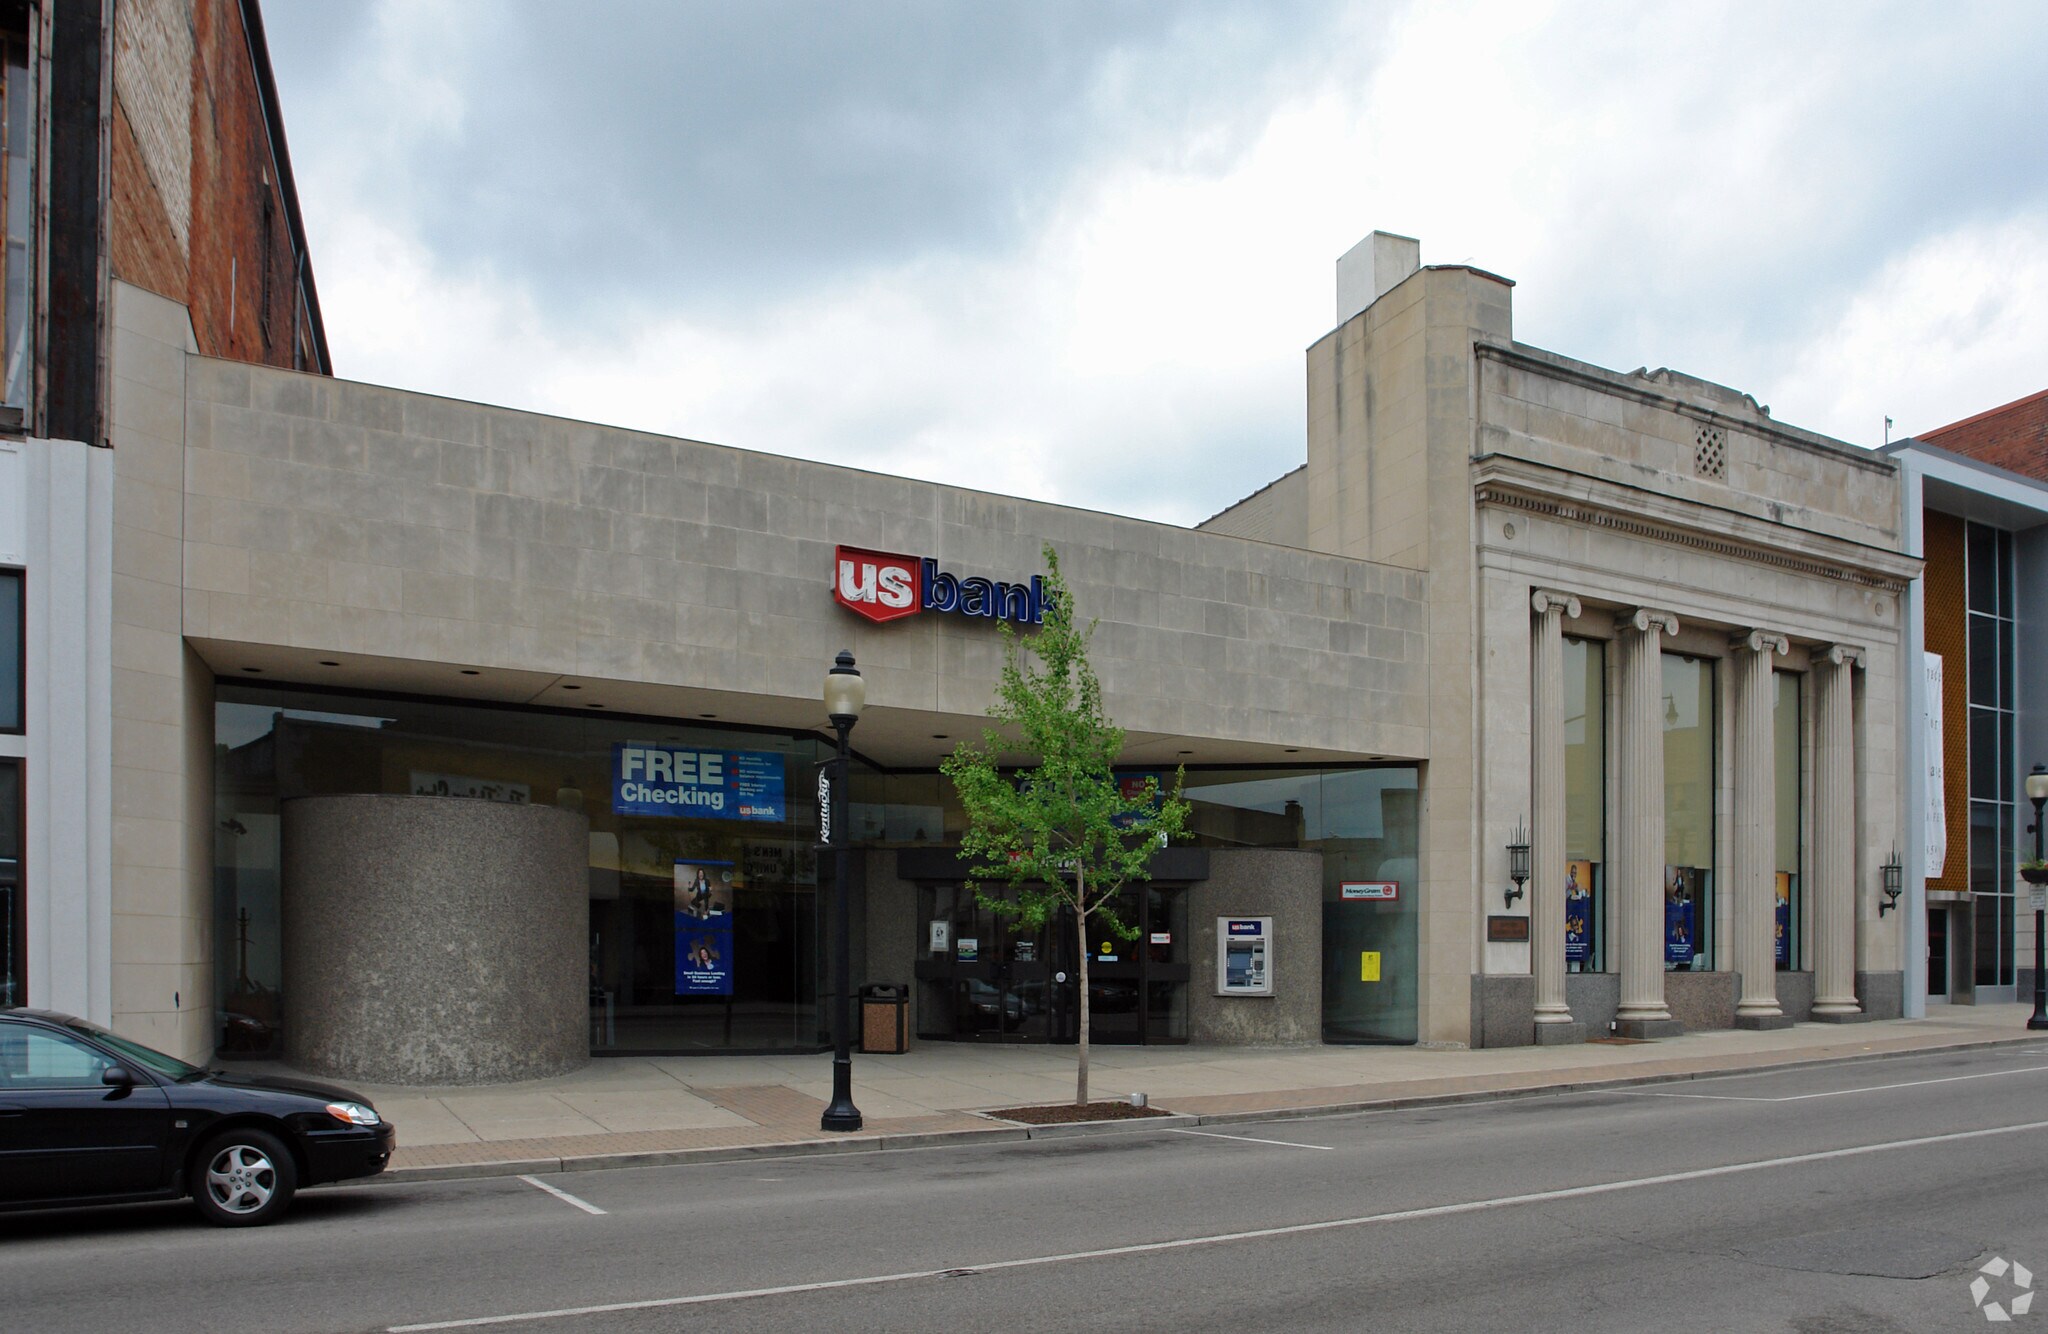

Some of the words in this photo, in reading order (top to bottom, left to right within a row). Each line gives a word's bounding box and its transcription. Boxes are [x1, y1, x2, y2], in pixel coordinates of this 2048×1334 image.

[839, 560, 913, 609] us
[622, 748, 723, 785] FREE
[620, 782, 724, 810] Checking
[1132, 780, 1145, 788] NO
[752, 805, 775, 815] bank
[817, 767, 835, 844] Kentucky
